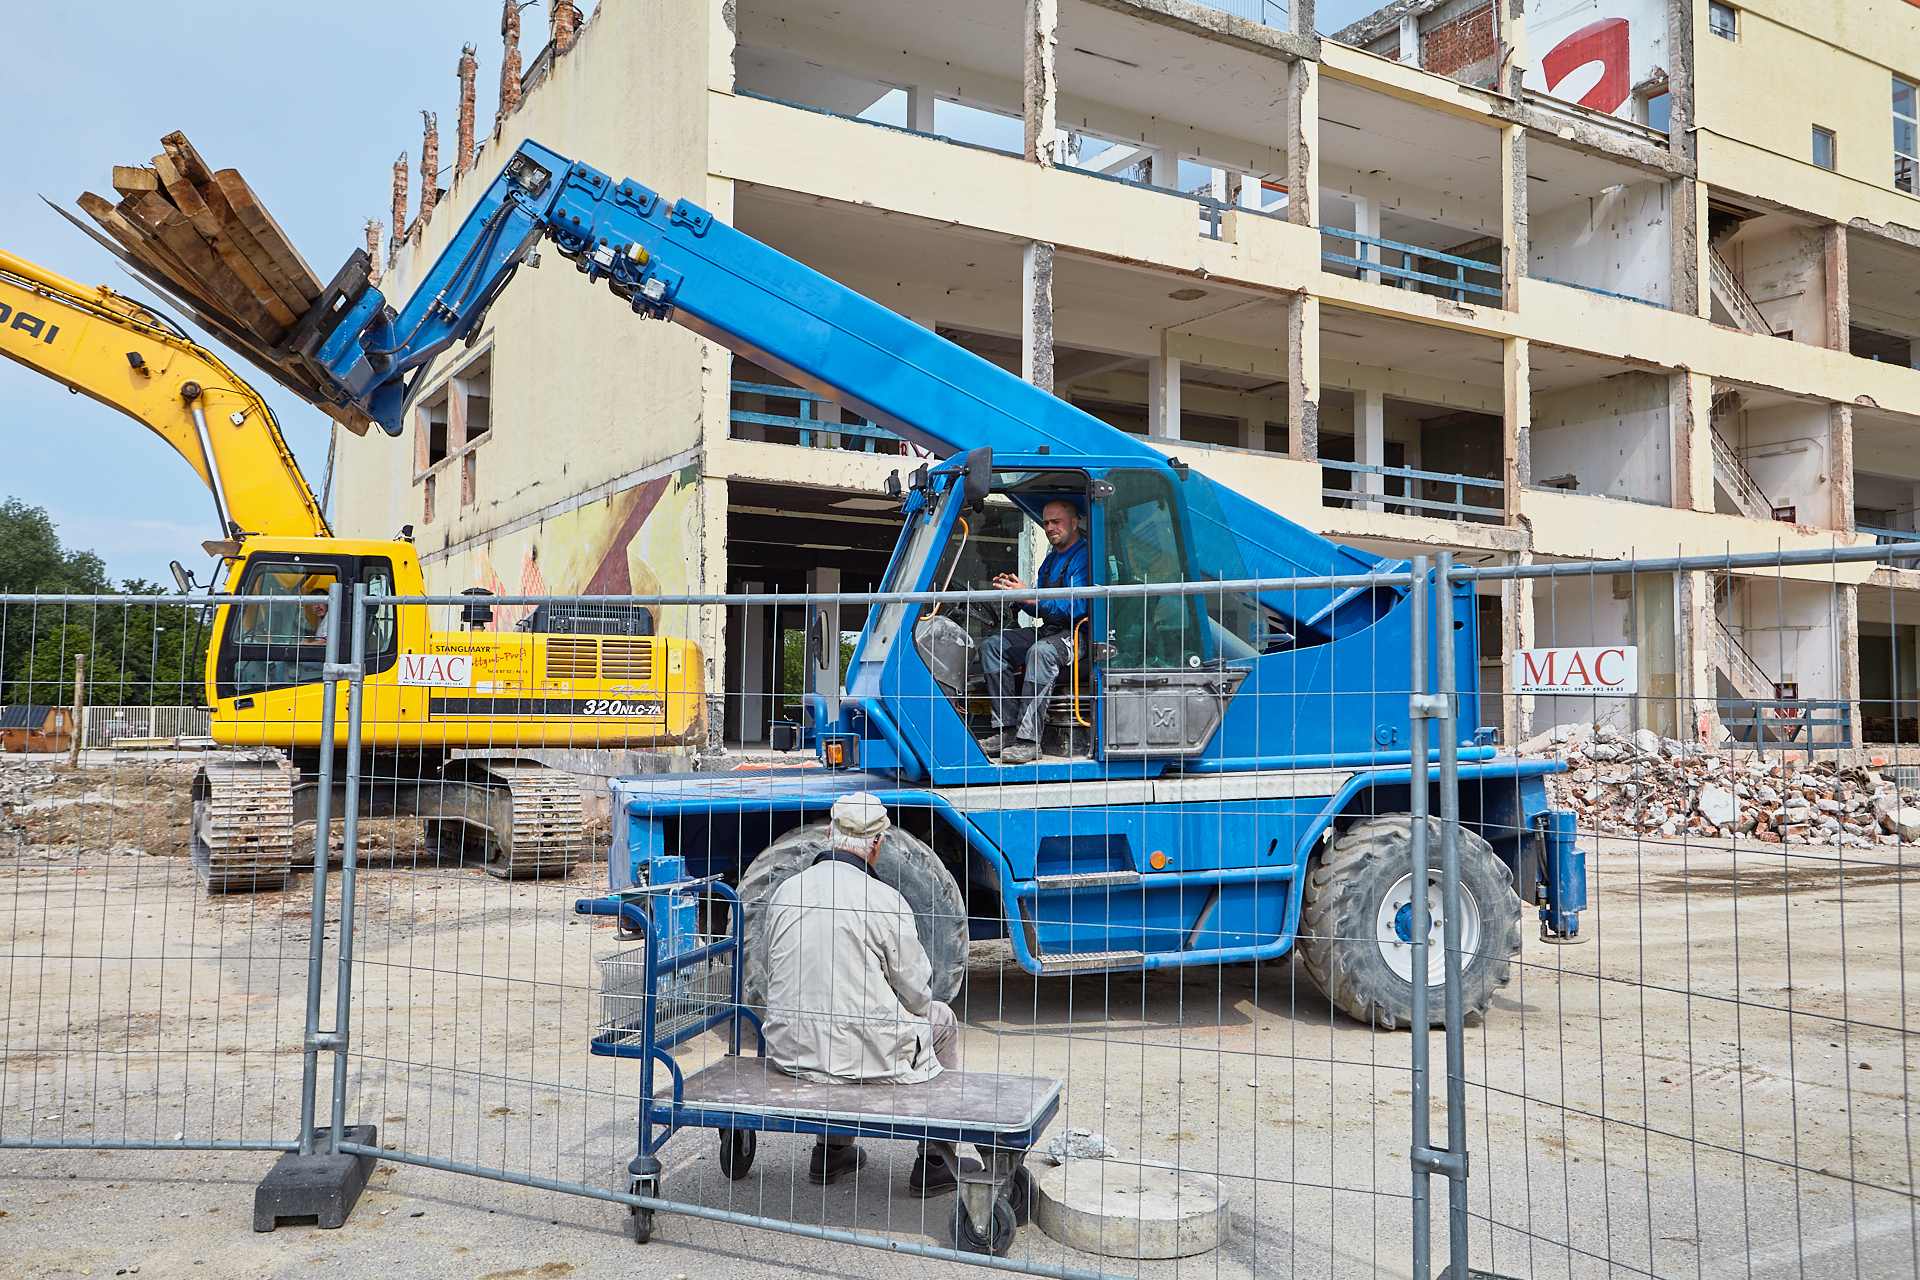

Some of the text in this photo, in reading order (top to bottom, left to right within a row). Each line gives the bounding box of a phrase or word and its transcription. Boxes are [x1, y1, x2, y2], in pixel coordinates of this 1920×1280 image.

[435, 645, 491, 653] STANGLMAYR
[404, 656, 465, 682] MAC
[1521, 649, 1625, 686] MAC
[583, 700, 662, 715] 320NLC-7A
